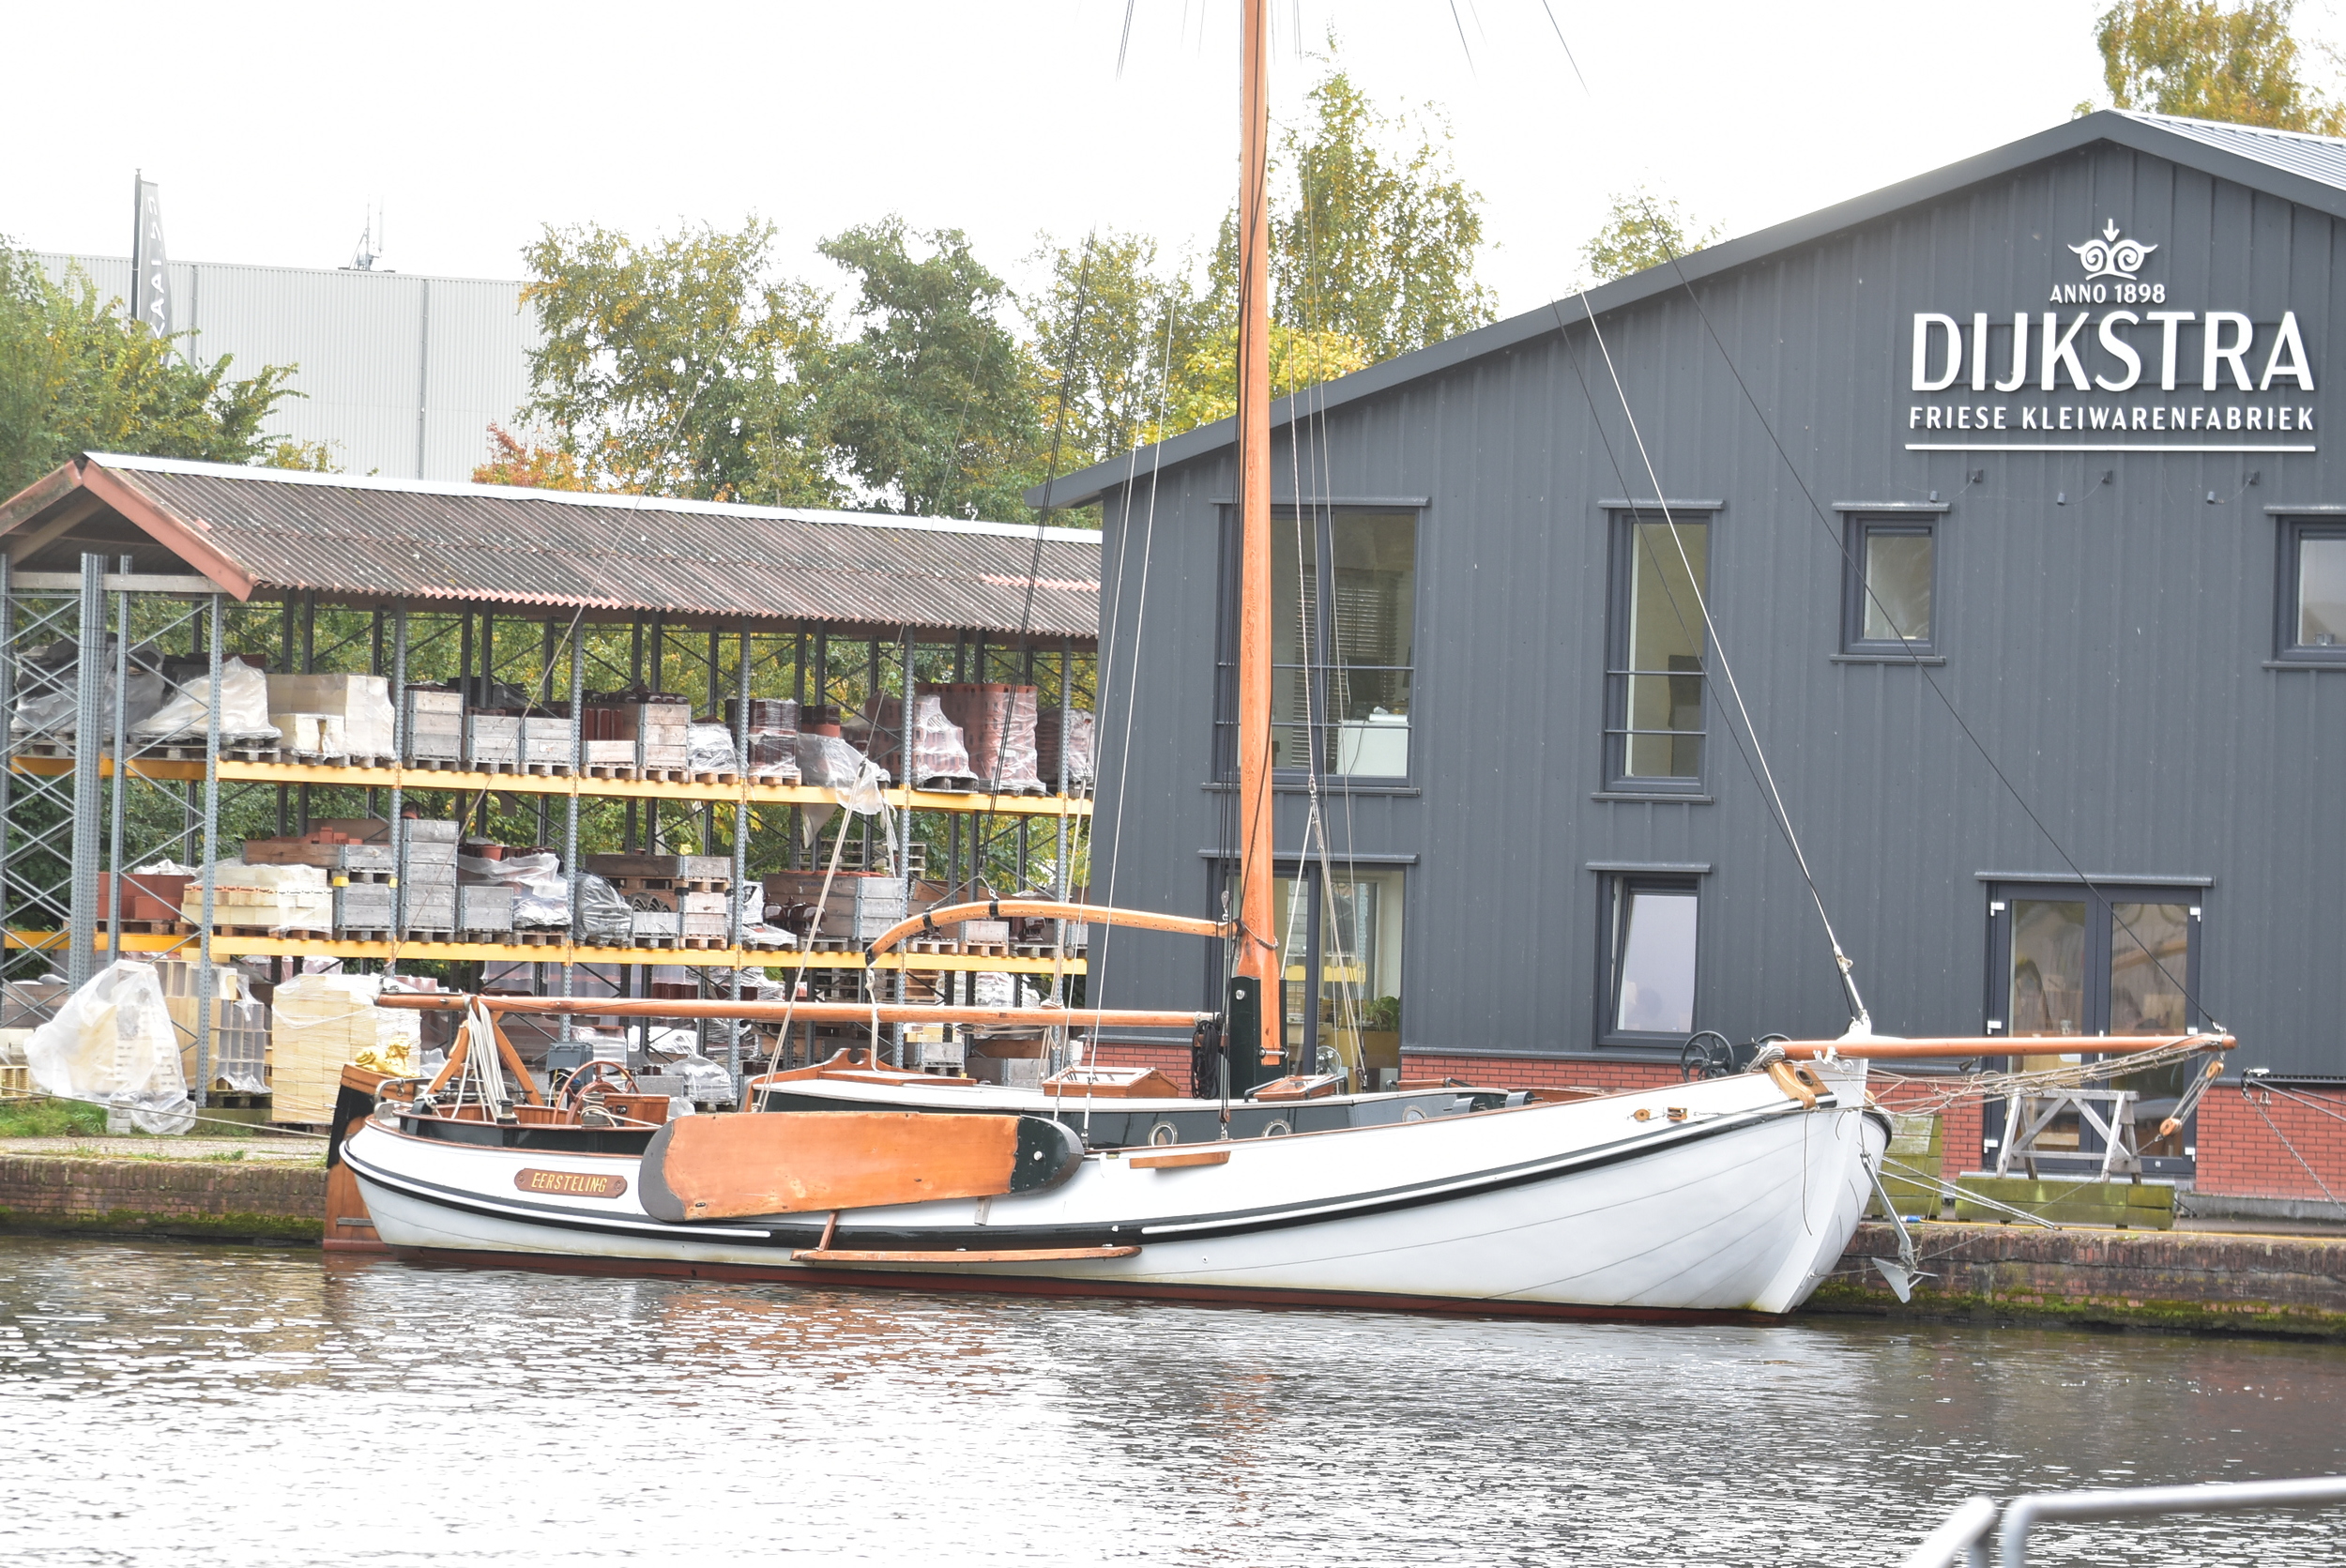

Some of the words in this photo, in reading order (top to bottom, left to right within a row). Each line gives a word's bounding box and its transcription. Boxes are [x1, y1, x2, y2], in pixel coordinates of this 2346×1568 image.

[2049, 283, 2107, 304] ANNO
[2114, 282, 2166, 304] 1898
[1912, 310, 2315, 392] DIJKSTRA
[1909, 405, 2007, 430] FRIESE
[2022, 406, 2313, 431] KLEIWARENFABRIEK
[531, 1172, 608, 1193] EERSTELING
